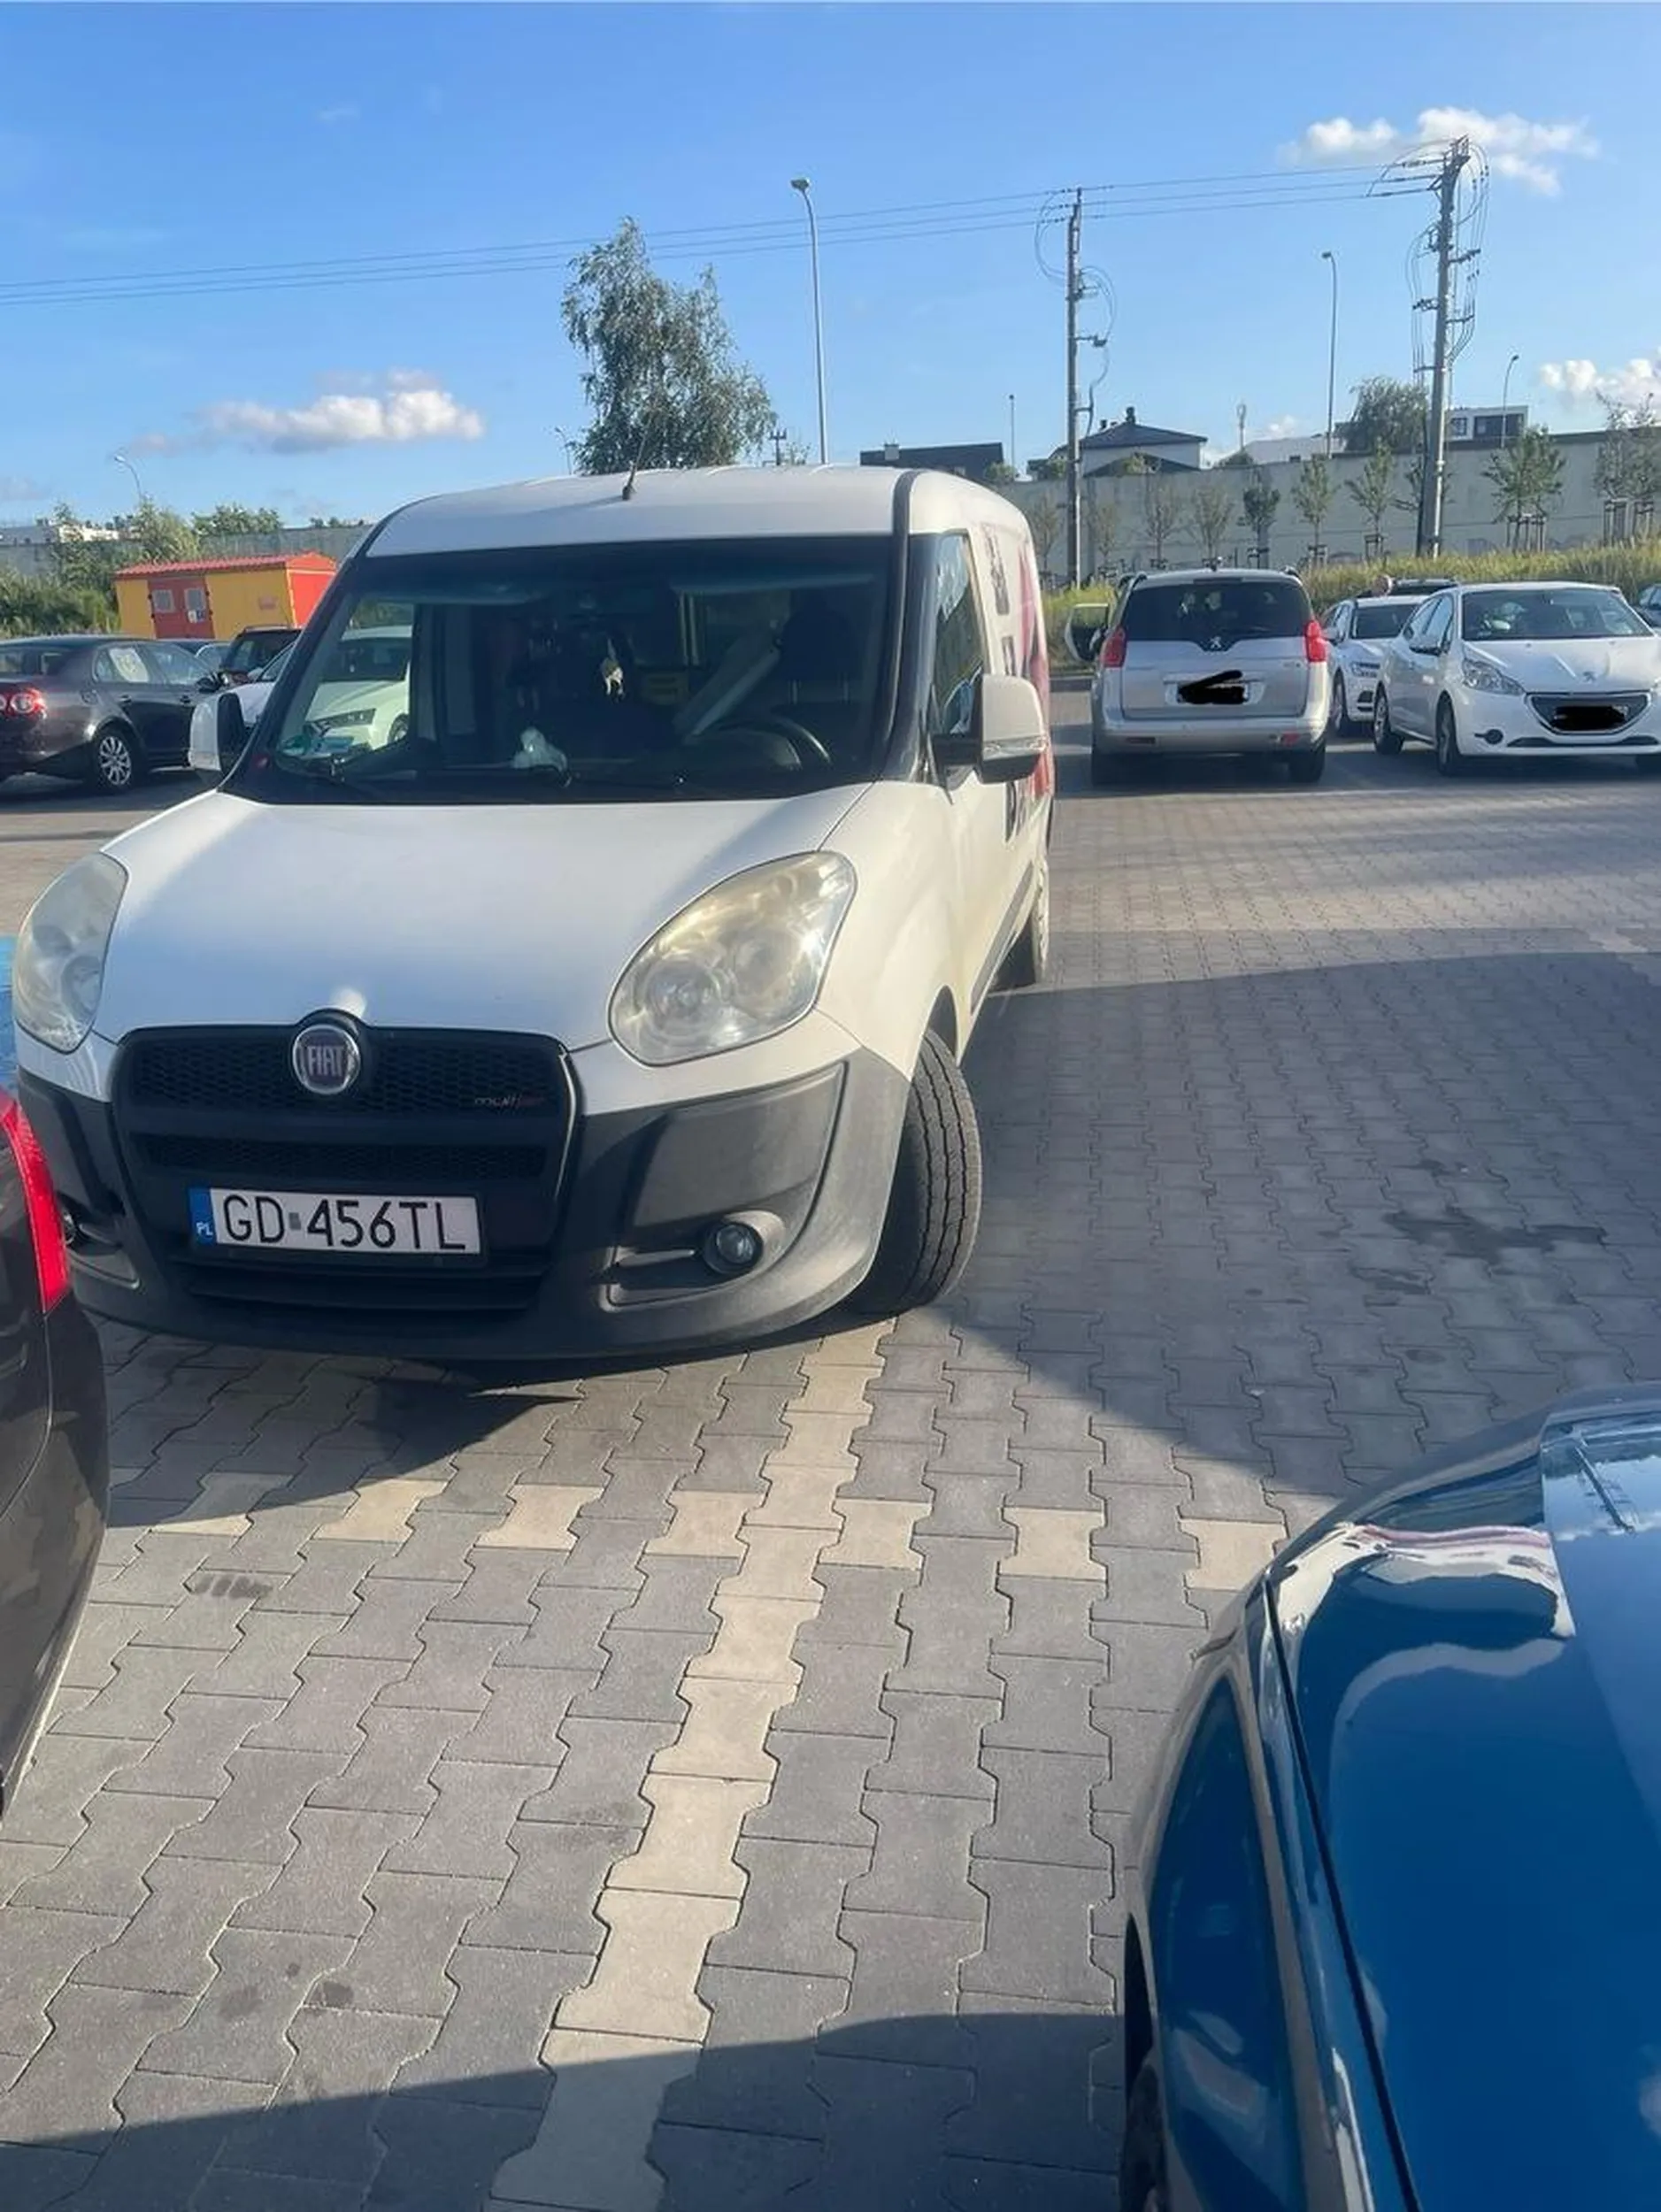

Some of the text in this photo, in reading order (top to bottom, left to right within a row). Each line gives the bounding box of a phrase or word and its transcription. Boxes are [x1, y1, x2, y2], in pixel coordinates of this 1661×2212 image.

[307, 1045, 344, 1076] FIAT
[196, 1221, 214, 1236] PL
[223, 1194, 466, 1249] GD 456TL
